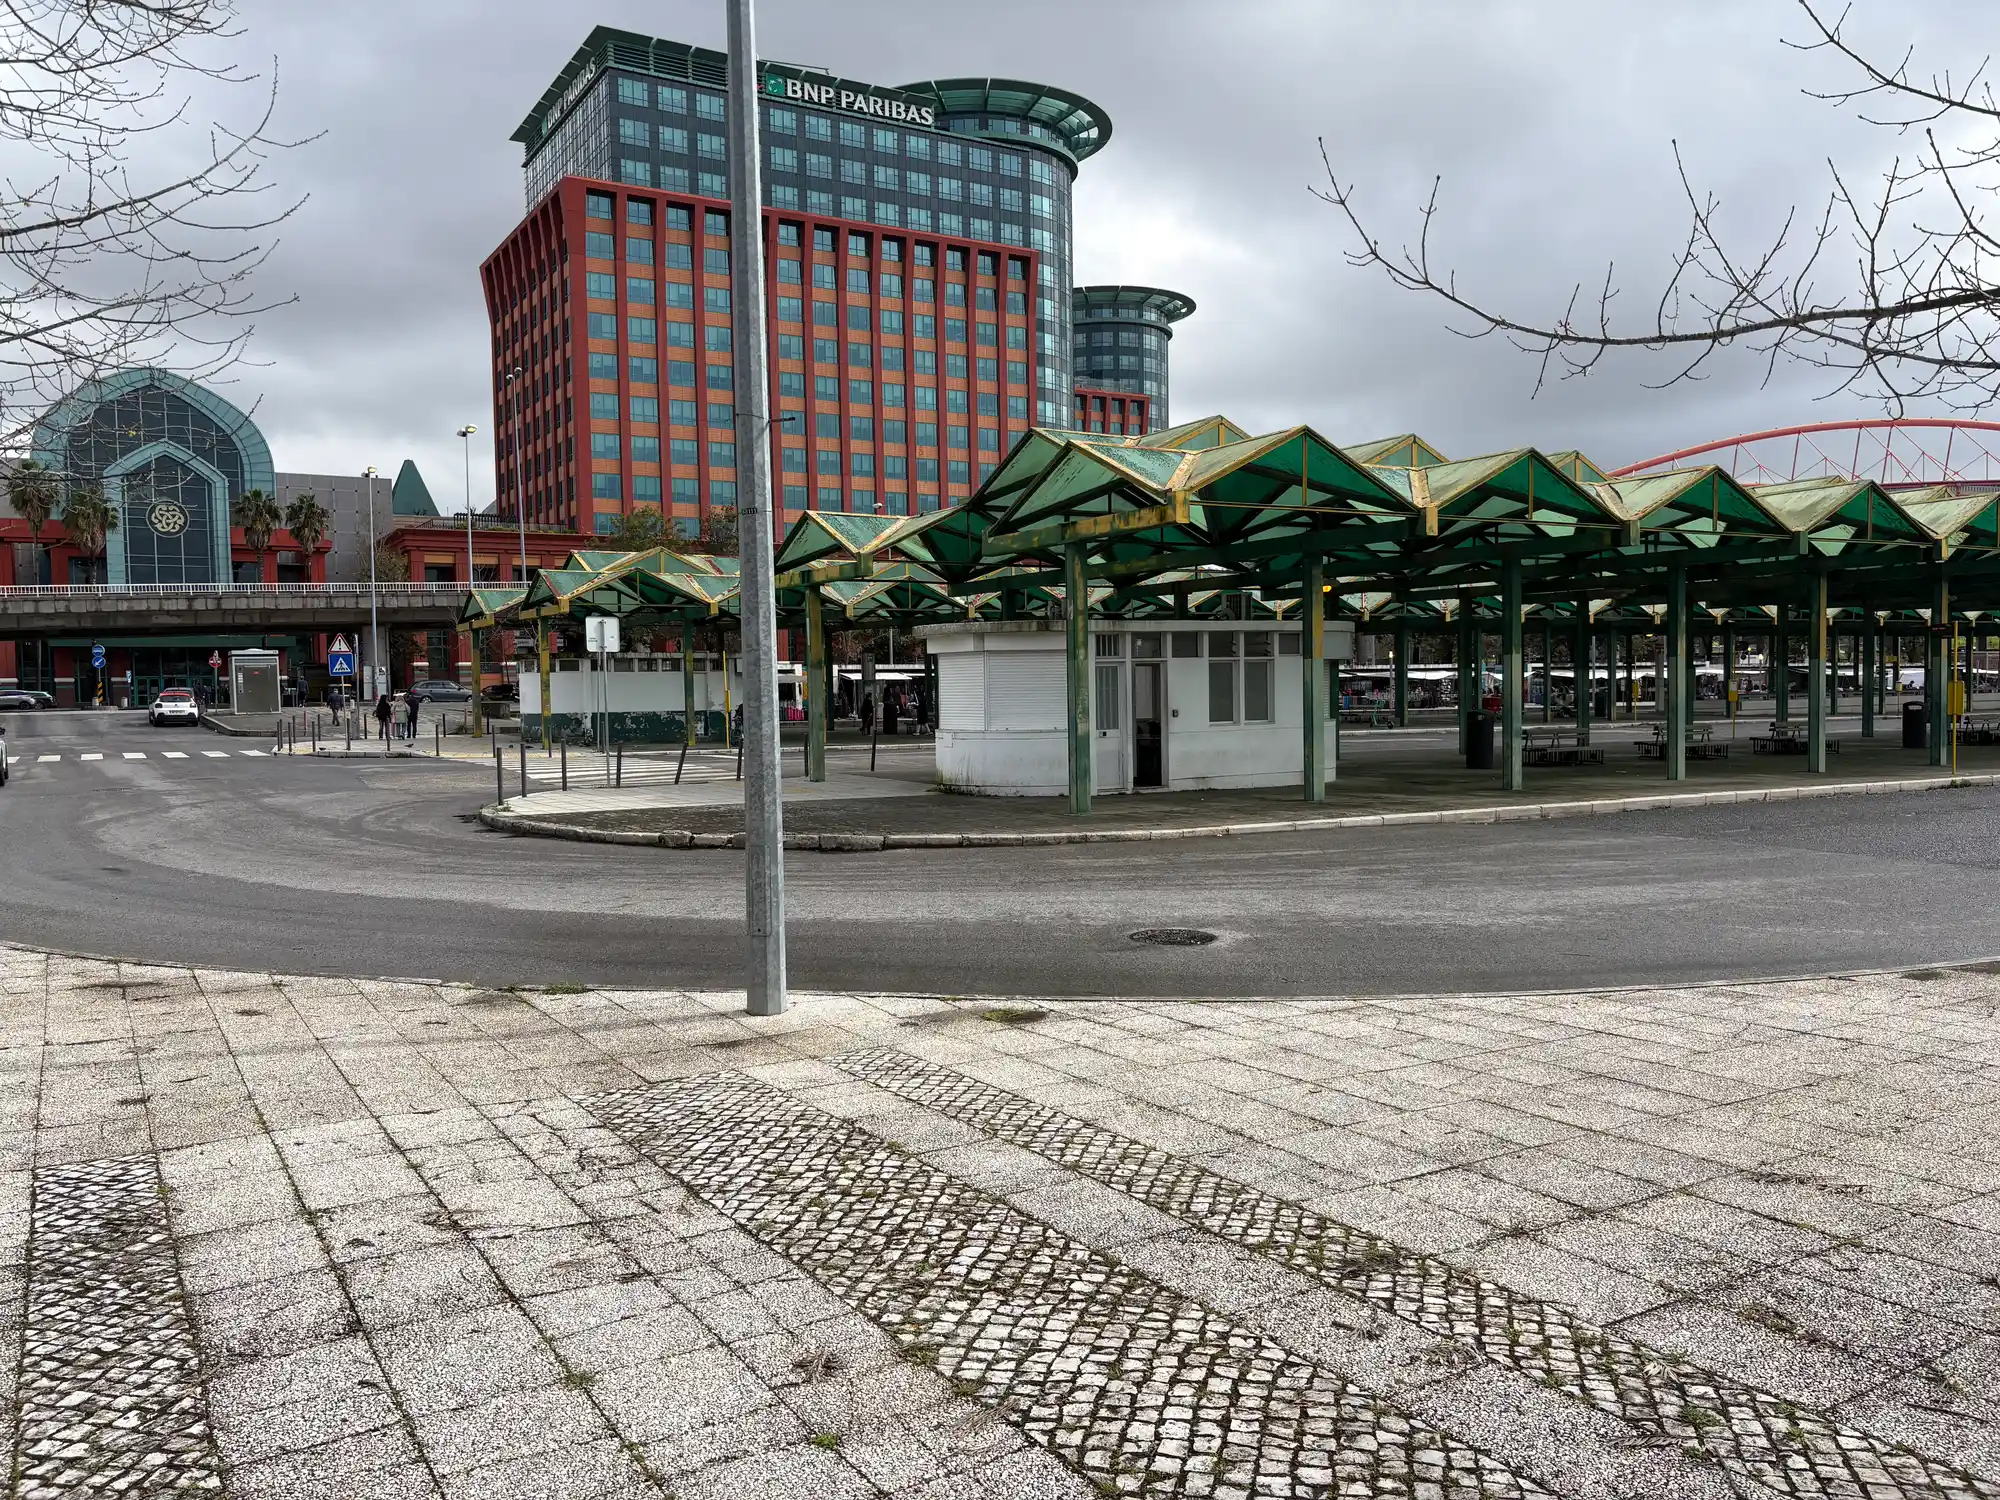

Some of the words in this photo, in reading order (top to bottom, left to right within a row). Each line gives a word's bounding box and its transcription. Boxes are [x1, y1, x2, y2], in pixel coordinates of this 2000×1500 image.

[547, 98, 563, 129] BNP
[563, 57, 596, 110] PARIBAS
[786, 78, 835, 104] BNP
[841, 90, 933, 125] PARIBAS
